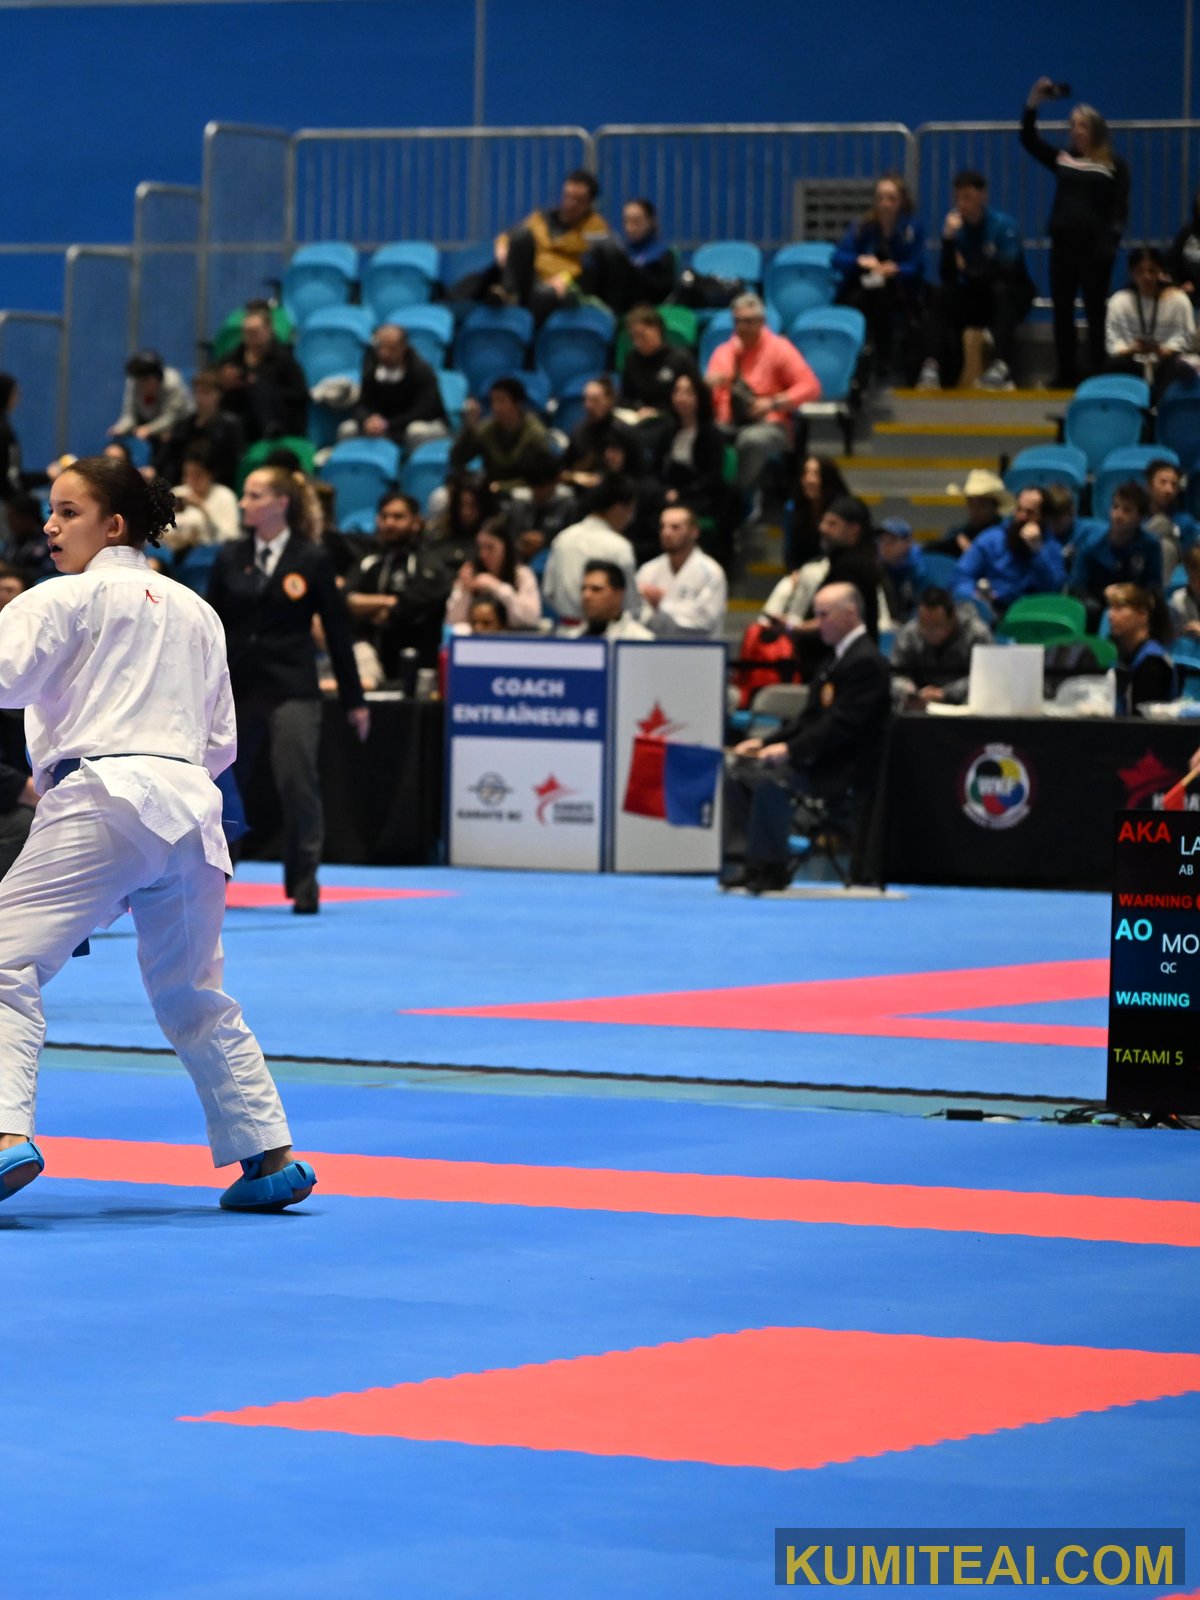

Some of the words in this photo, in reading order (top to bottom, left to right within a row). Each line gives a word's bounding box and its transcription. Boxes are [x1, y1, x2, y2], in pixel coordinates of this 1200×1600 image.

[491, 676, 565, 698] COACH
[1118, 820, 1171, 843] AKA
[1178, 864, 1194, 876] AB
[1119, 894, 1192, 909] WARNING
[1115, 918, 1153, 941] AO
[1162, 933, 1200, 954] MO
[1160, 962, 1177, 974] QC
[1115, 991, 1190, 1008] WARNING
[1114, 1048, 1170, 1065] TATAMI
[1175, 1051, 1184, 1066] 5
